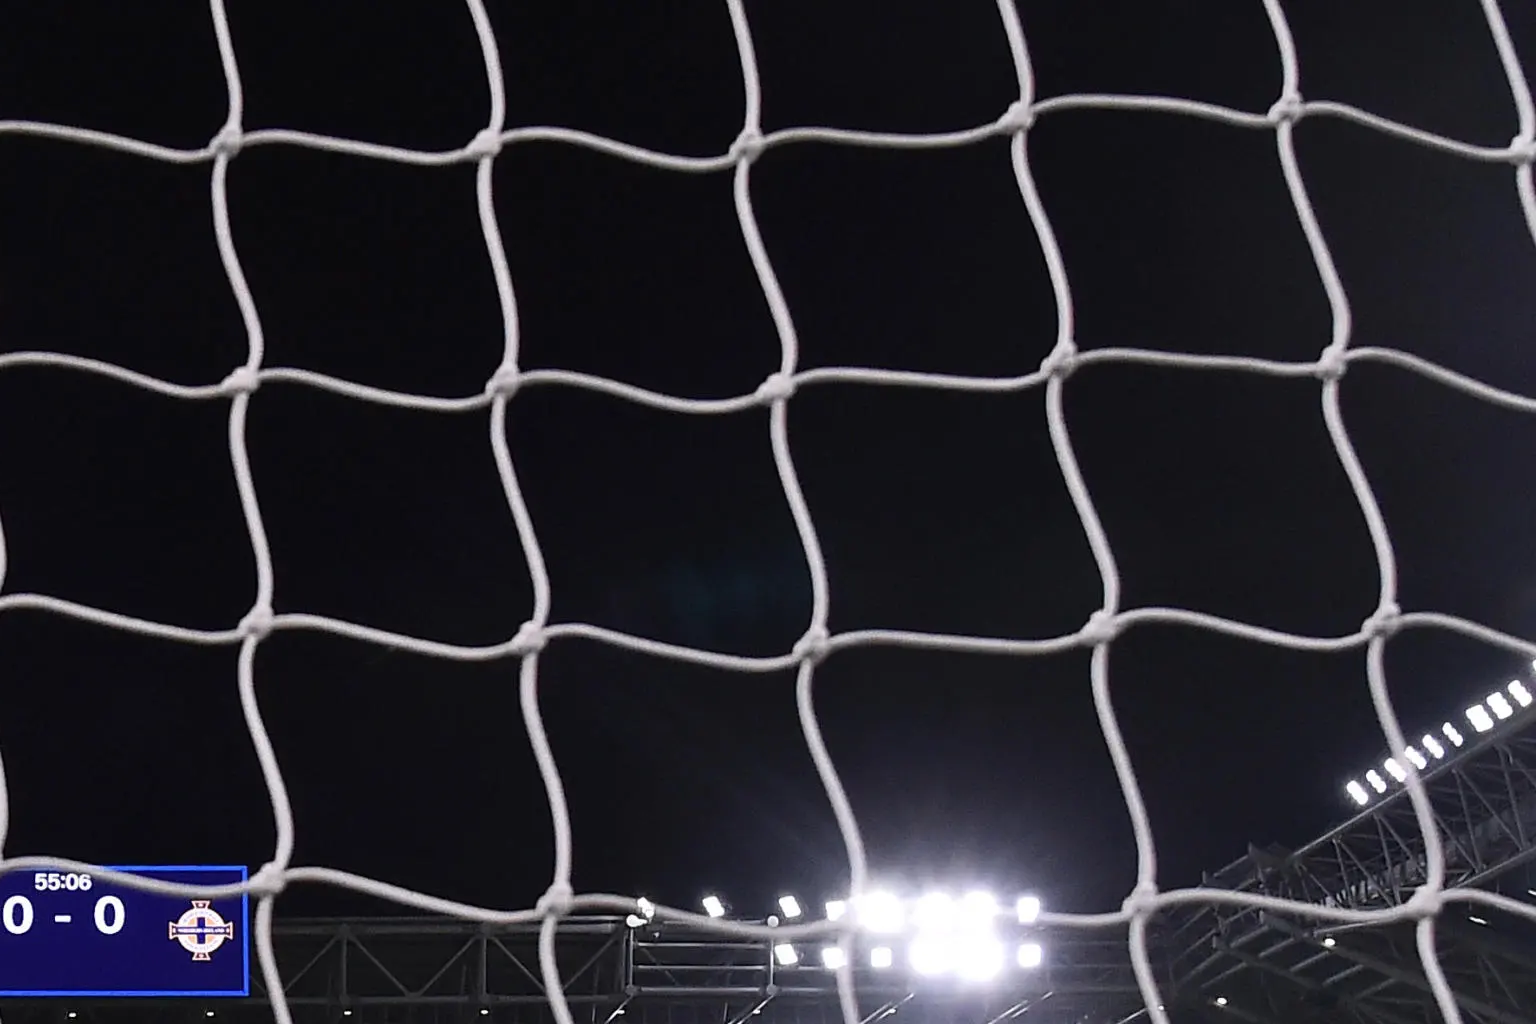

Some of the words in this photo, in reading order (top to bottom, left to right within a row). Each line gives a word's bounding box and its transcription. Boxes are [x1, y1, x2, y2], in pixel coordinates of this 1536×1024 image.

[34, 873, 92, 891] 55:06
[2, 895, 34, 935] 0
[93, 895, 125, 935] 0
